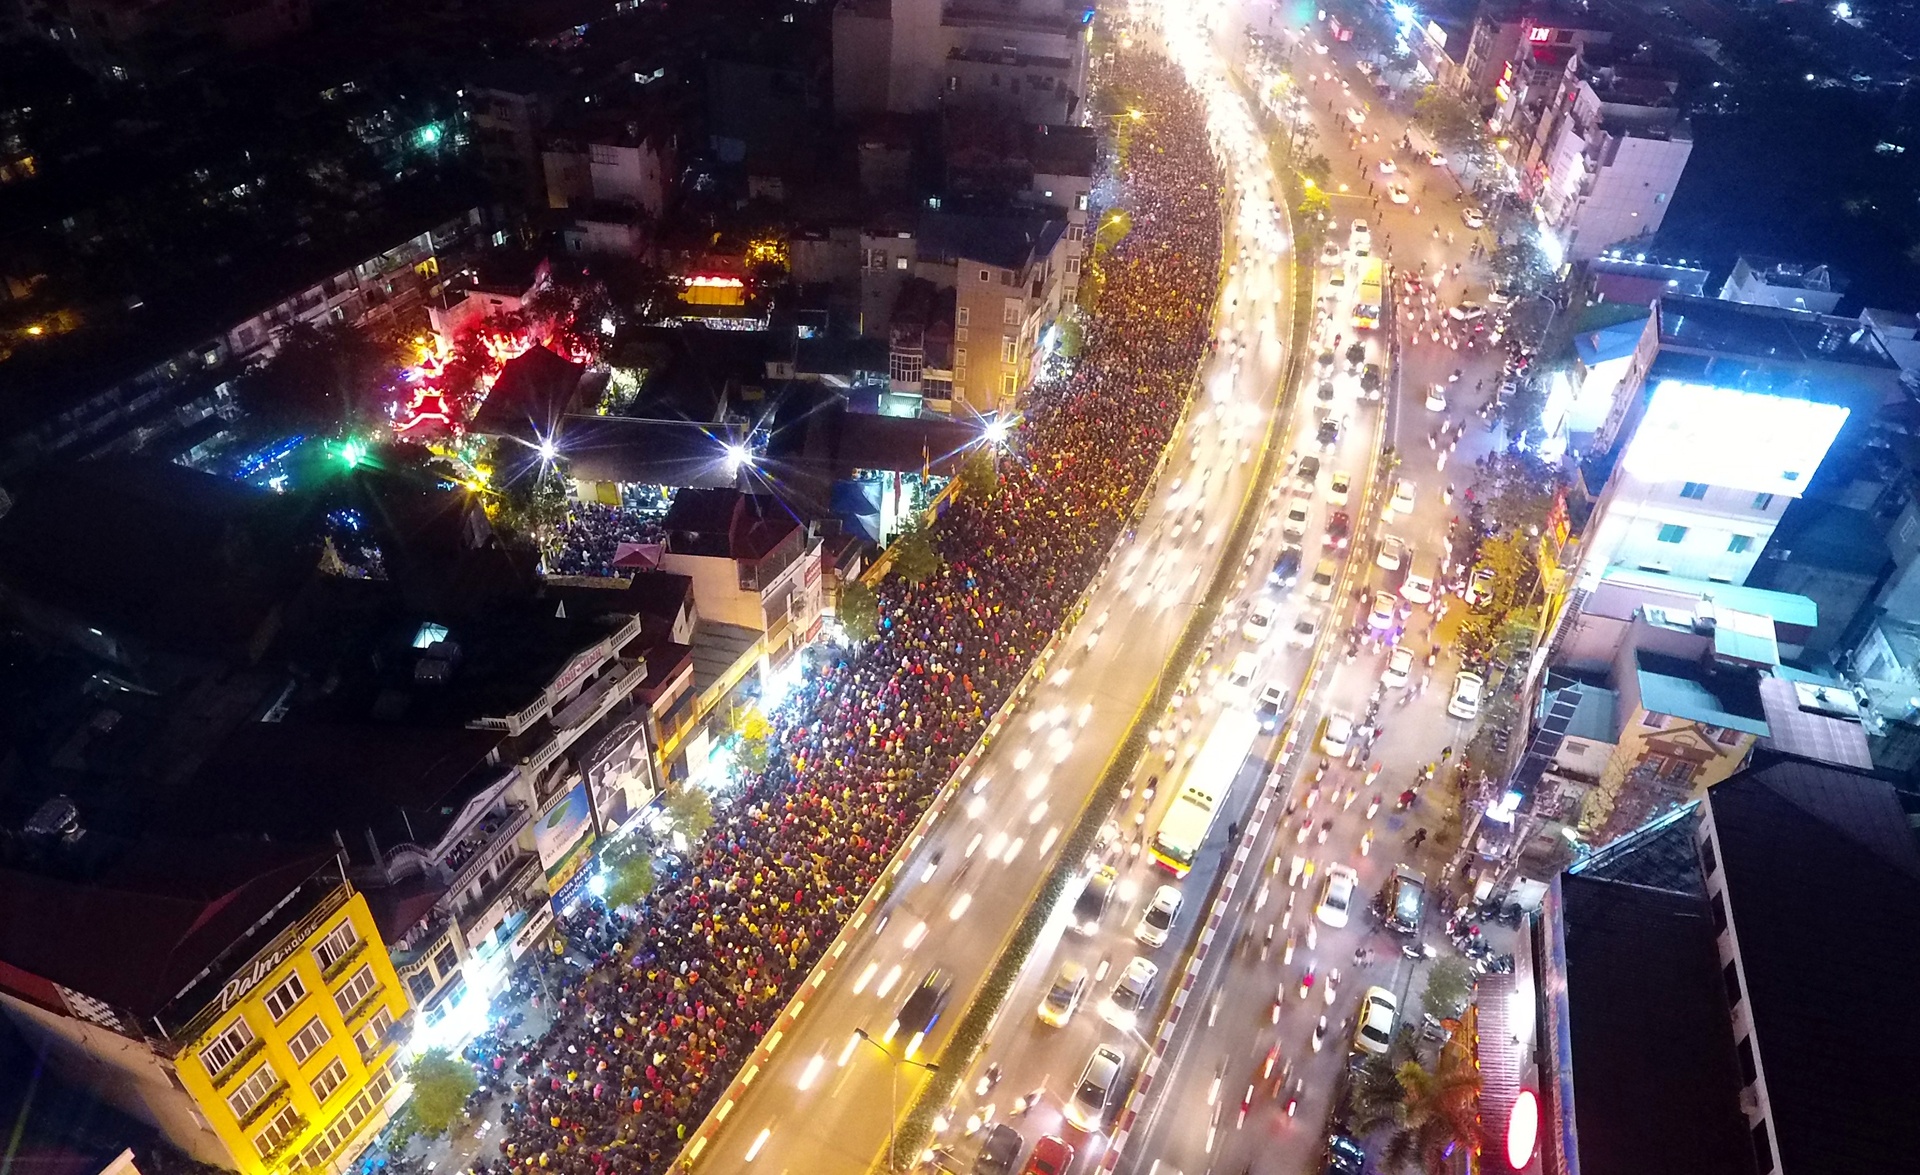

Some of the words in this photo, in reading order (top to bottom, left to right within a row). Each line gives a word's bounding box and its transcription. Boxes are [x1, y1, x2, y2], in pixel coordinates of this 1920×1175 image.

[1529, 27, 1550, 41] IN
[212, 951, 284, 1012] Palm
[284, 922, 318, 955] HOUSE
